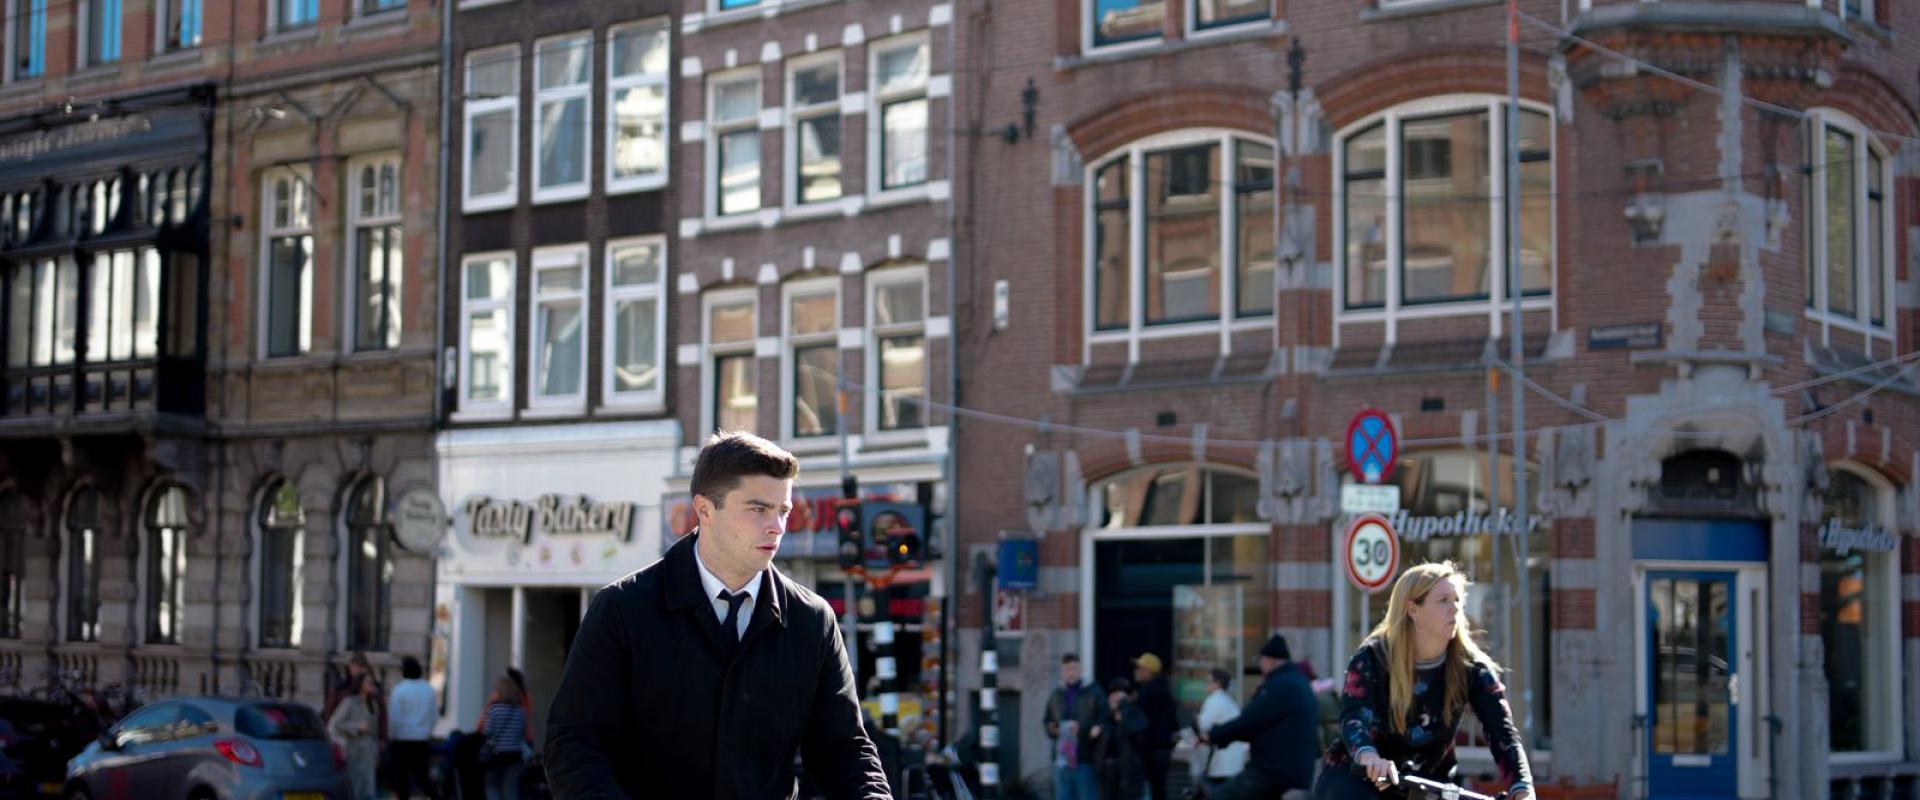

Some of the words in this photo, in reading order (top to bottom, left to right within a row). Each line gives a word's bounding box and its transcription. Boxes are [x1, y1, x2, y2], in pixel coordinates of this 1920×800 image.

[466, 497, 534, 544] Tasty
[536, 494, 636, 543] Bakery
[1392, 507, 1543, 541] Hypothekr
[1355, 537, 1389, 567] 30
